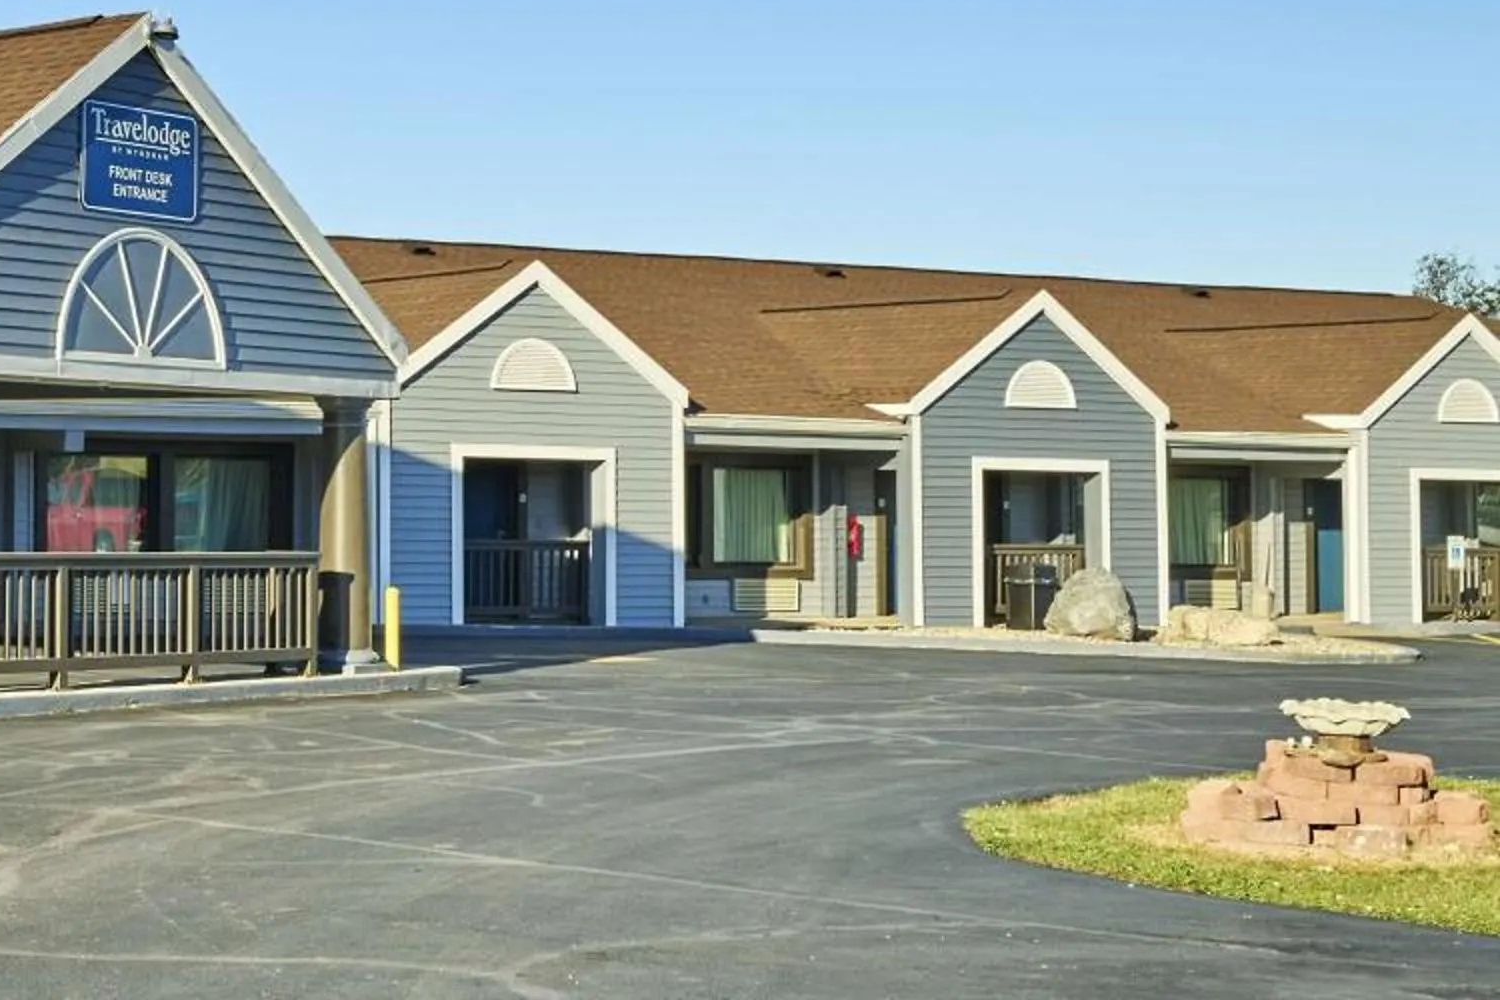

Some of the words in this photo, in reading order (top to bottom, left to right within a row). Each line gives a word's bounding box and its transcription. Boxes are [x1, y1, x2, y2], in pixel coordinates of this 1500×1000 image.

[90, 107, 191, 156] Travelodge
[108, 164, 143, 181] FRONT
[145, 171, 173, 187] DESK
[113, 183, 168, 203] ENTRANCE
